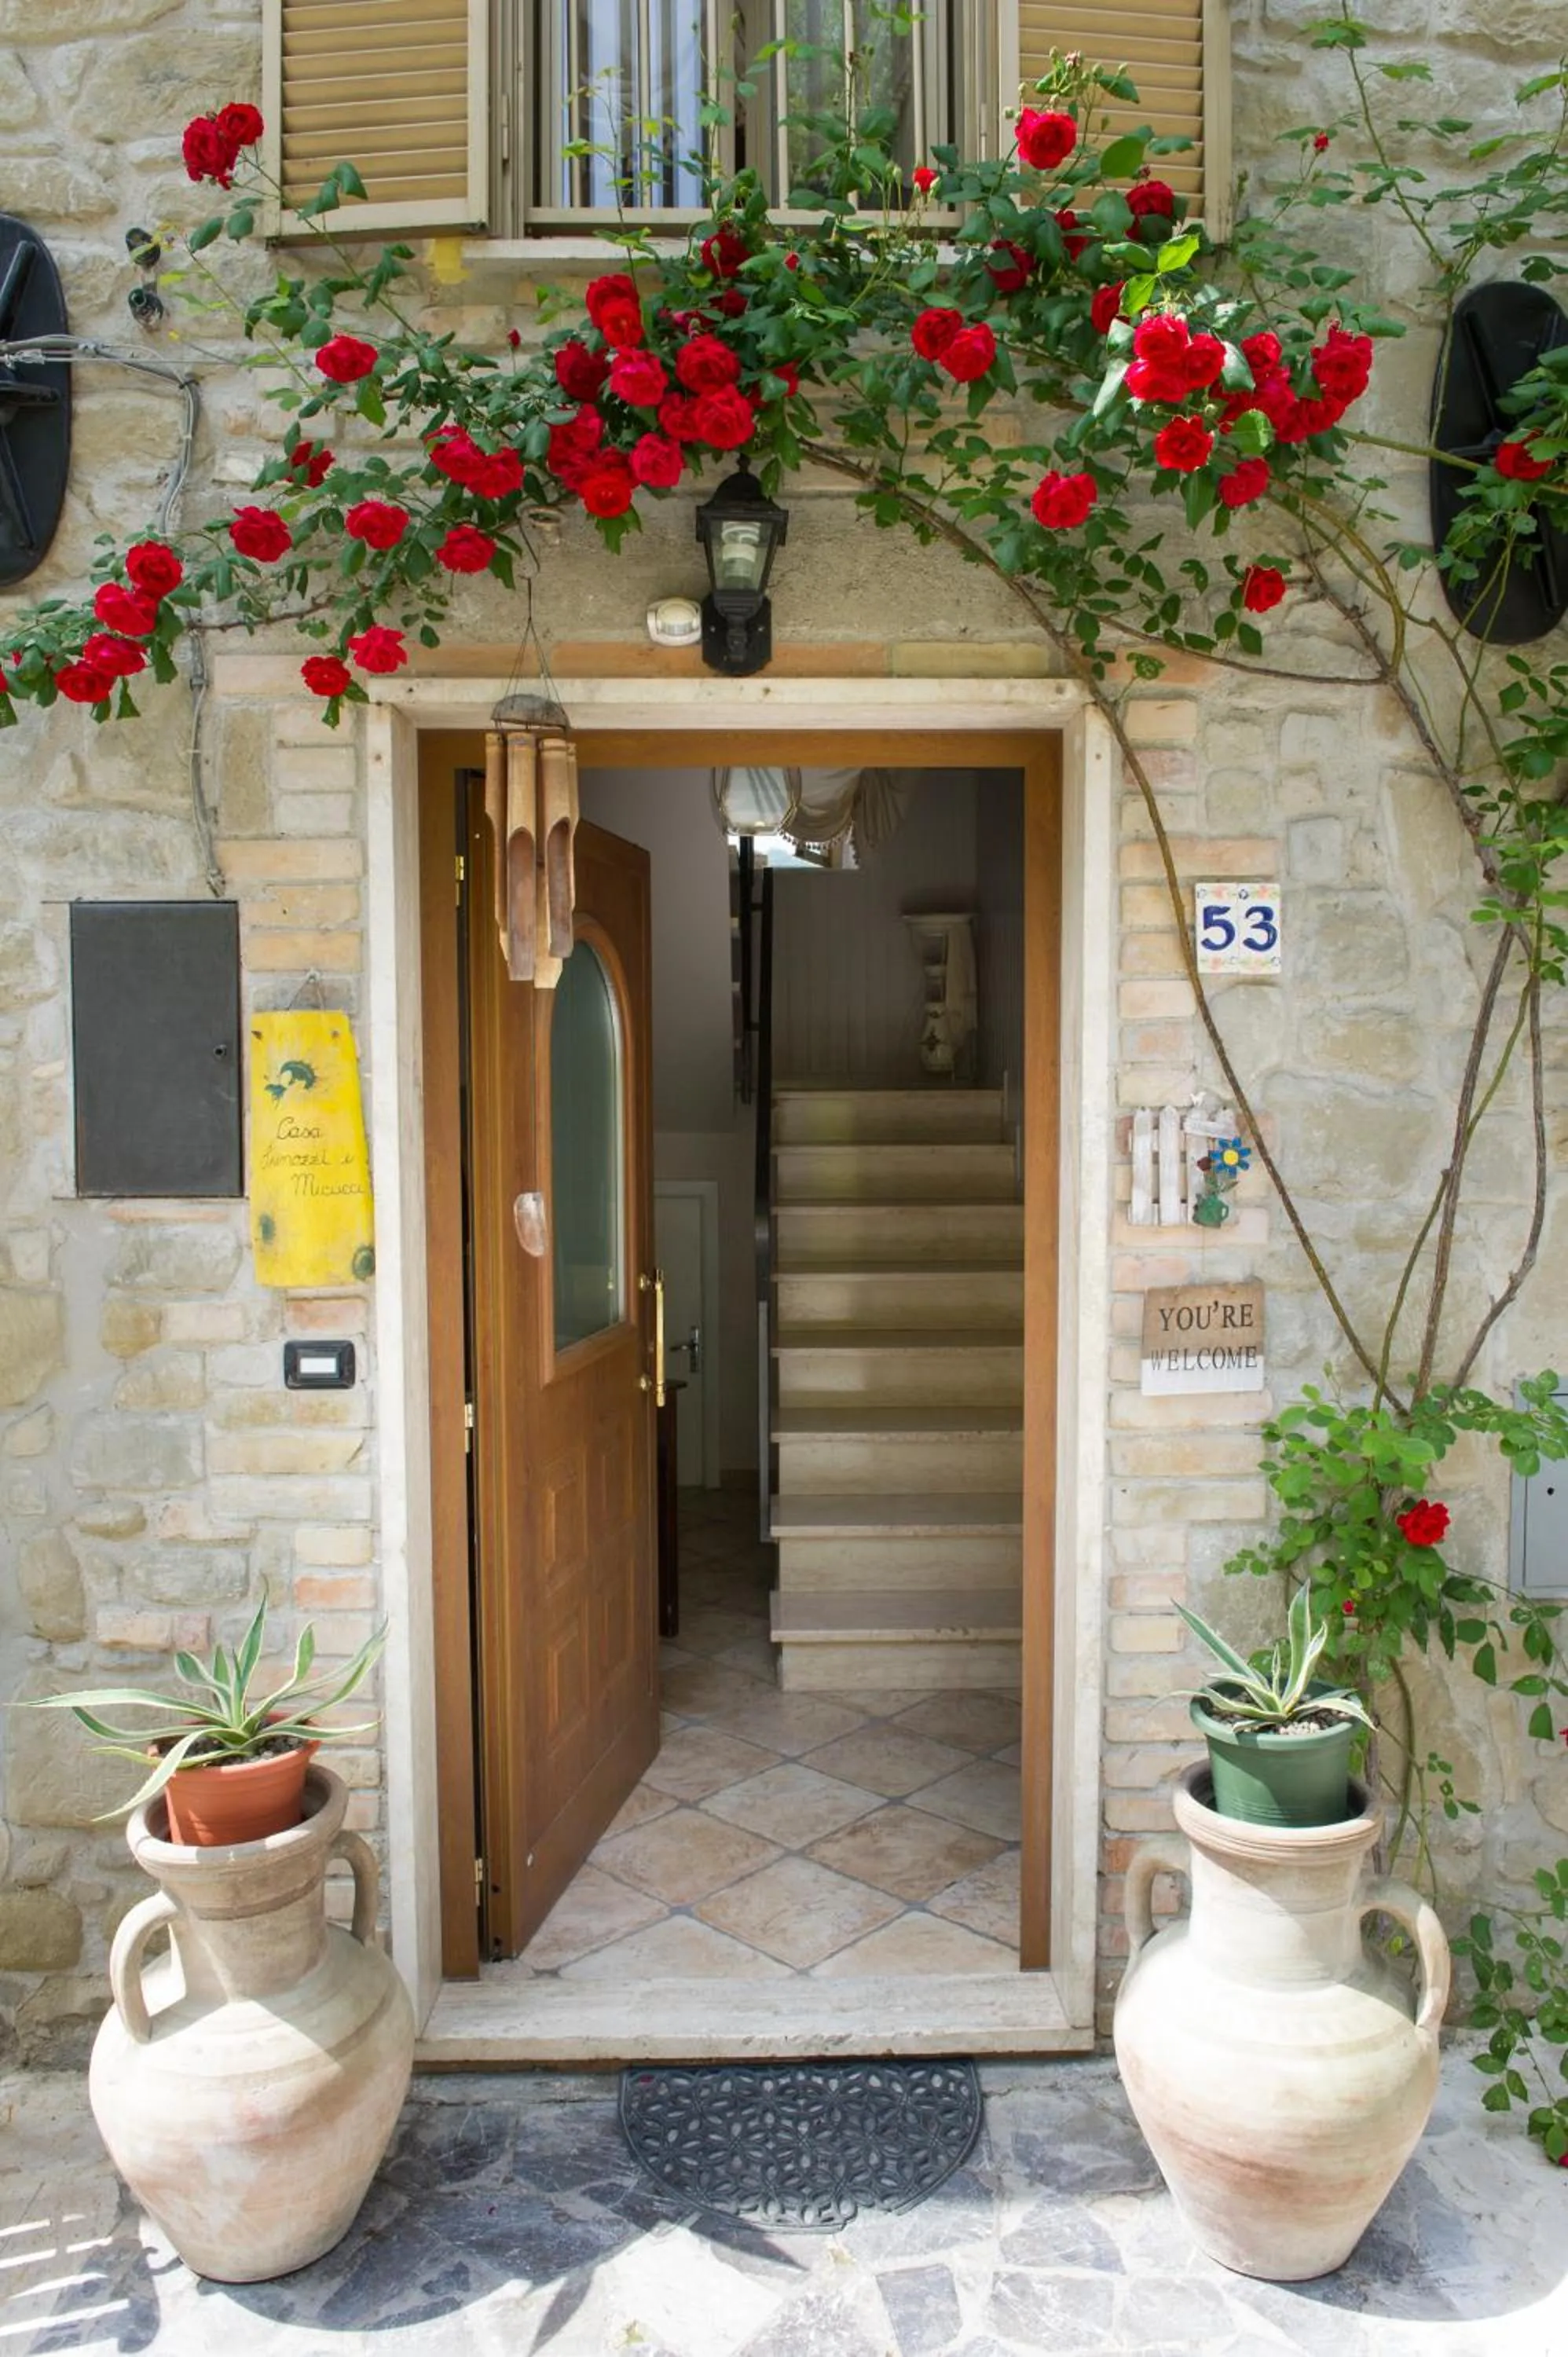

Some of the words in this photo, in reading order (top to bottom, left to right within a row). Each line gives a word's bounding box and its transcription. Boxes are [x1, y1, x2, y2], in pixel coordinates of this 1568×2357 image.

[1201, 905, 1277, 951] 53
[276, 1116, 322, 1140] Casa
[1160, 1300, 1254, 1332] YOU'RE
[1151, 1346, 1258, 1371] WELCOME
